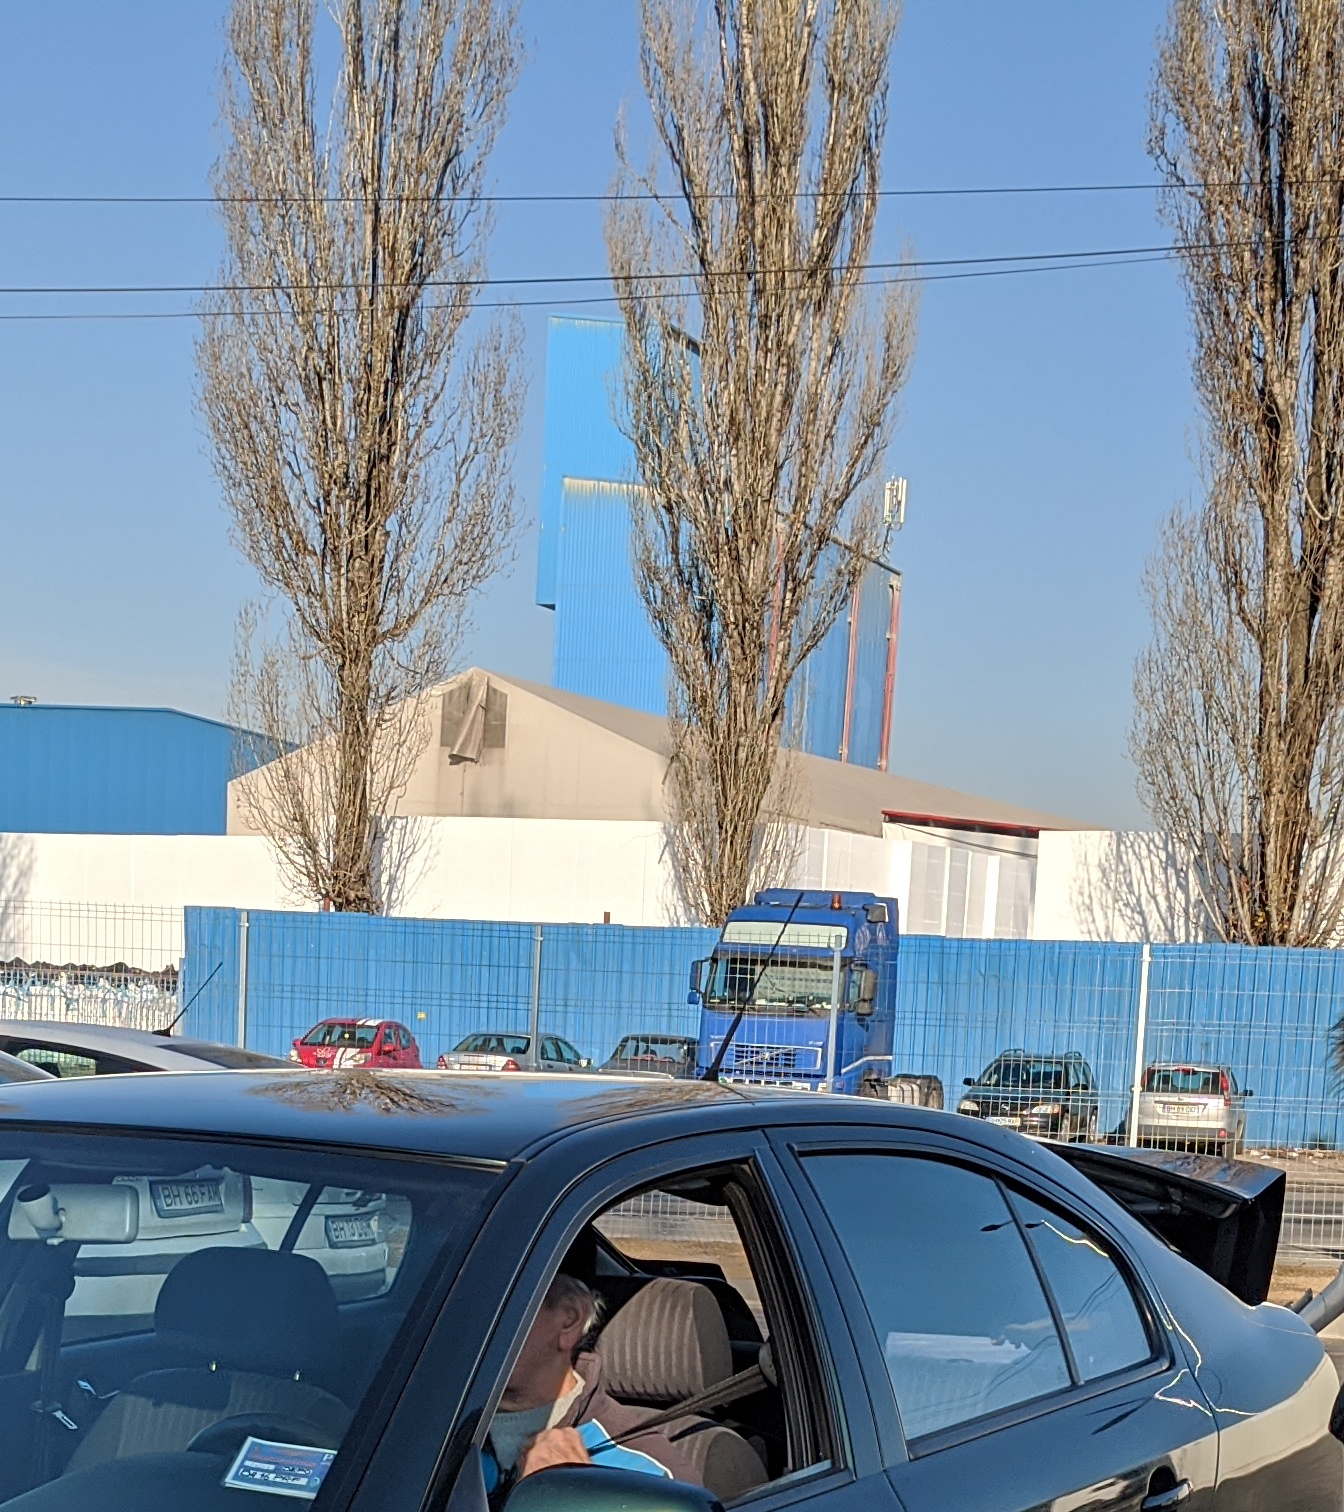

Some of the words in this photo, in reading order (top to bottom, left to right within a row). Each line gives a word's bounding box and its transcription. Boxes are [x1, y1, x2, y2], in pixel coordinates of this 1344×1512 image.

[161, 1185, 183, 1207] BH
[184, 1184, 199, 1205] 66
[331, 1220, 346, 1239] BH
